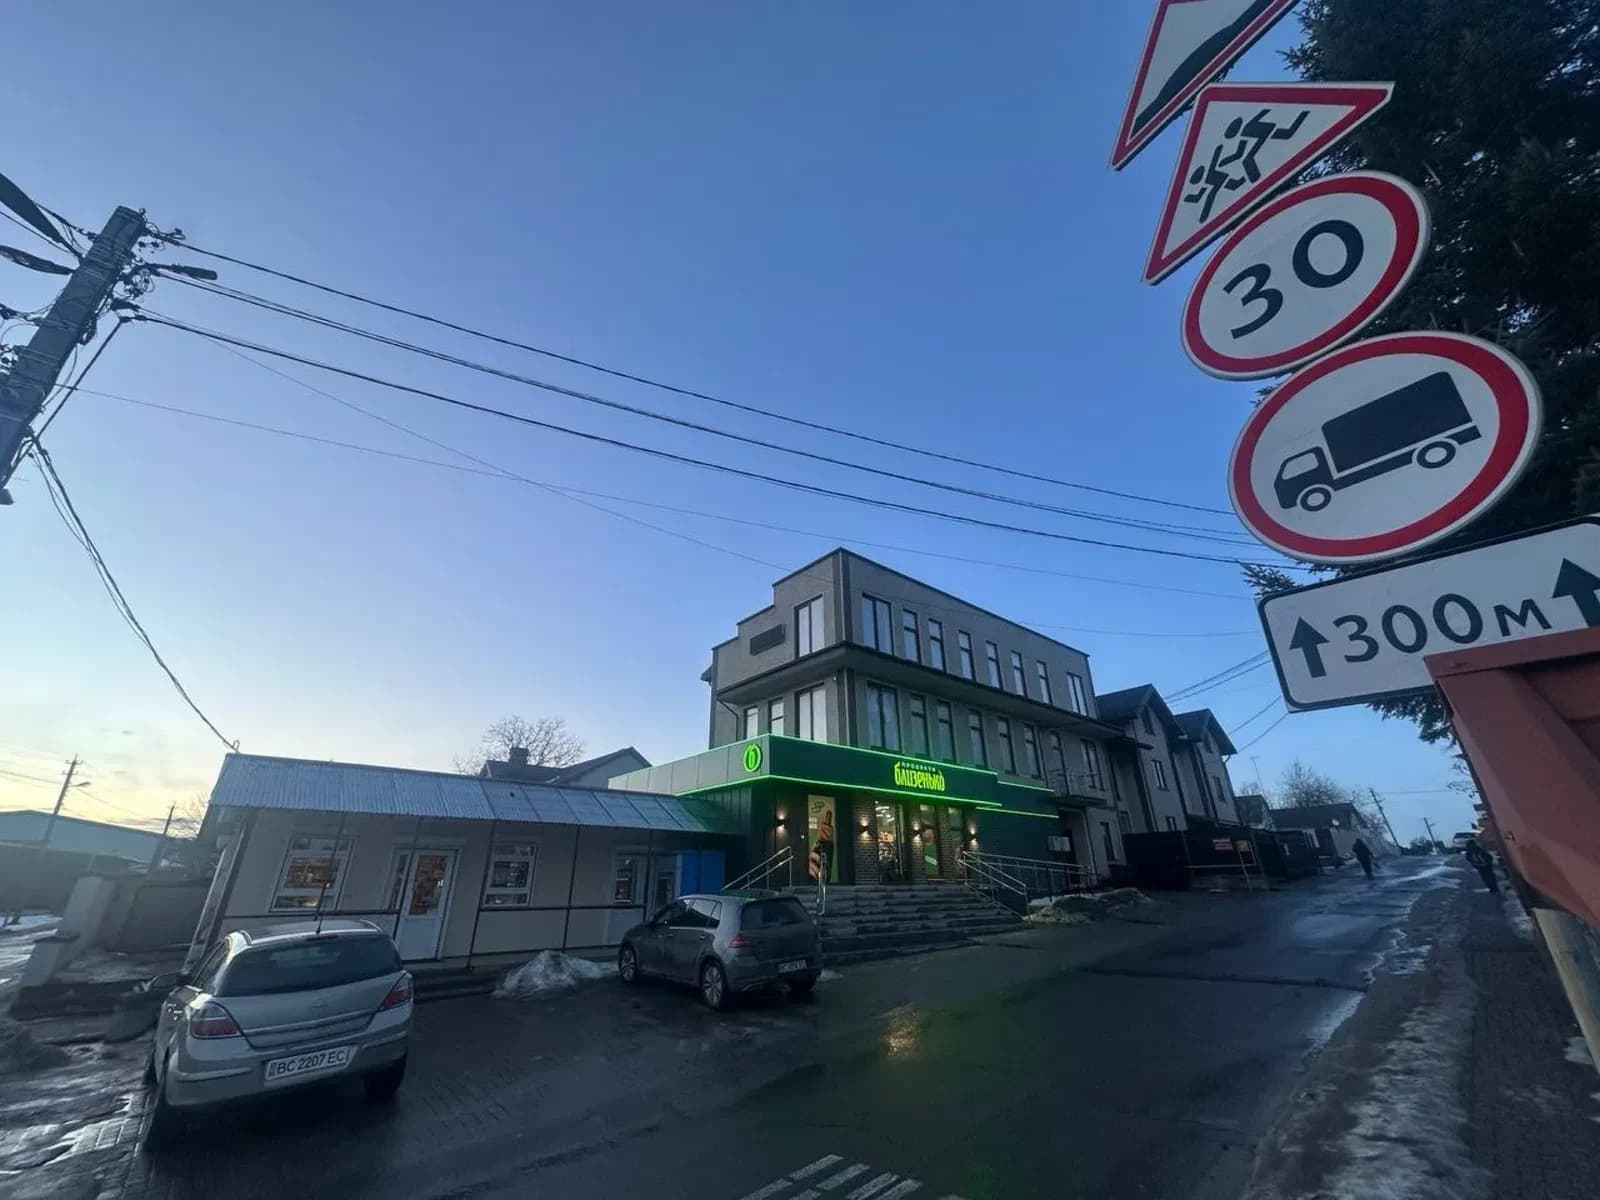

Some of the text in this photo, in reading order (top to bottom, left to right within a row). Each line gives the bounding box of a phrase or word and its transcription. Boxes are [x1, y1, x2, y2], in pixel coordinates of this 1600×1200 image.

[1223, 219, 1364, 340] 30
[277, 1051, 345, 1075] BC 2207 EC
